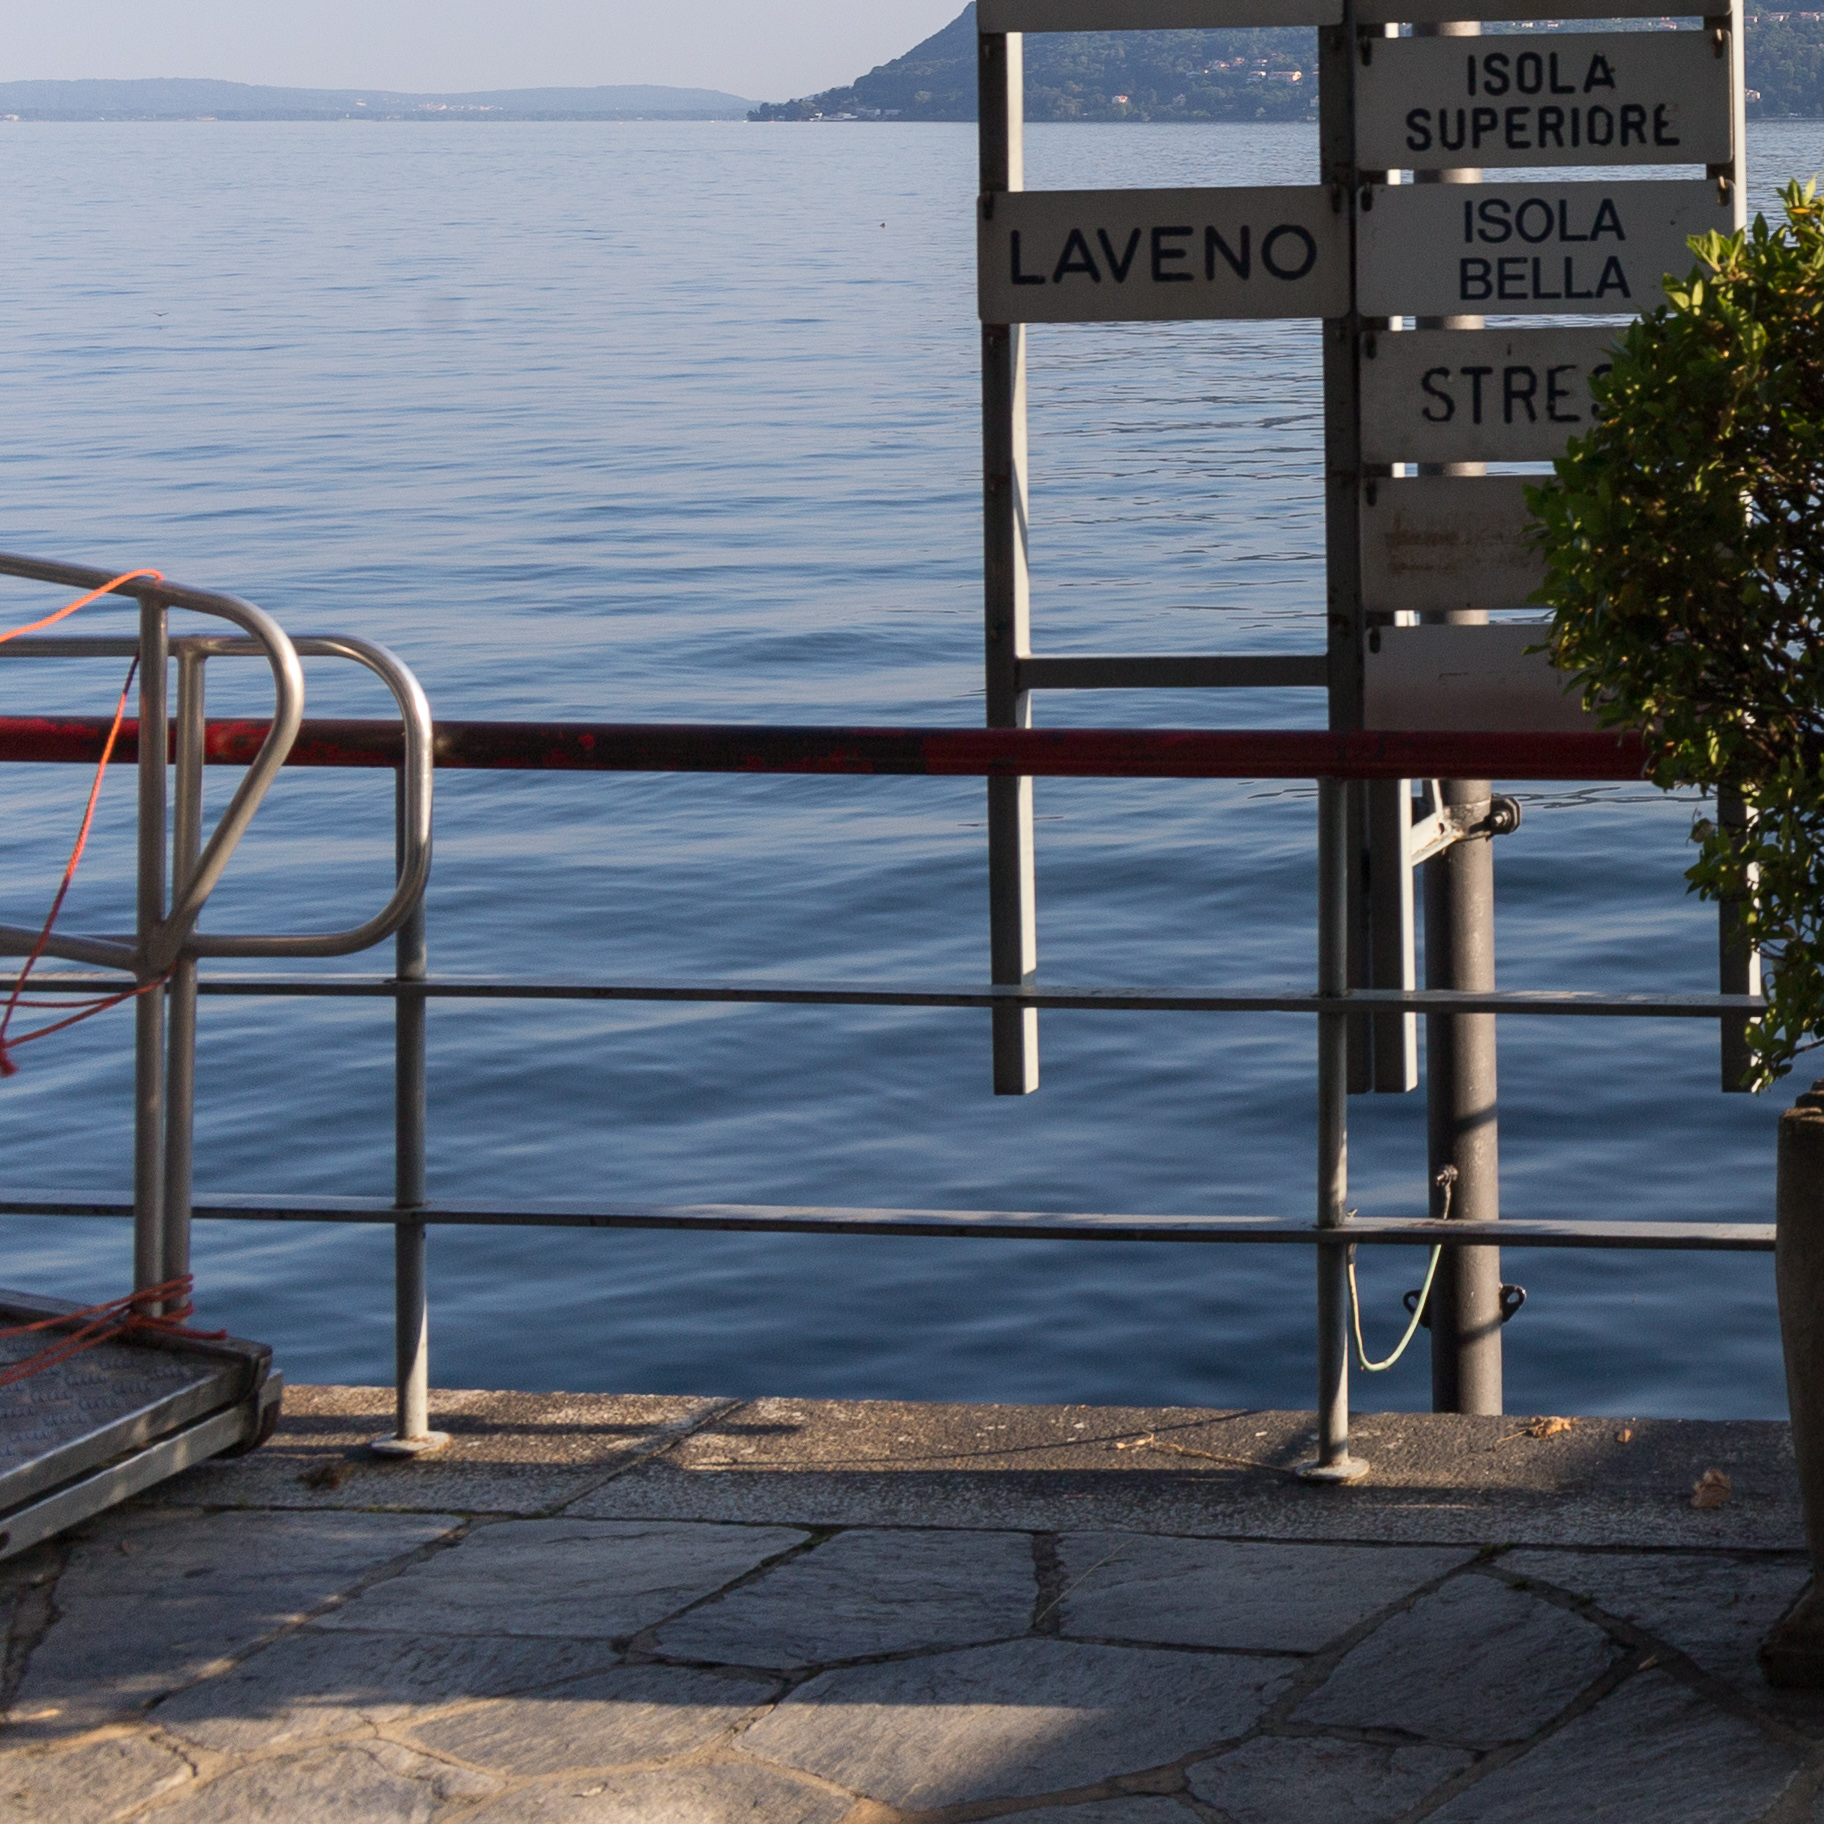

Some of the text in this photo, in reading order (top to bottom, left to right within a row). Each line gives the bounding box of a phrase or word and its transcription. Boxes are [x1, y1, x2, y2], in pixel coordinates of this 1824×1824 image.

[1467, 51, 1616, 97] ISOLA
[1405, 102, 1681, 152] SUPERIORE
[1464, 197, 1626, 244] ISOLA
[1010, 223, 1318, 286] LAVENO
[1459, 255, 1632, 301] BELLA
